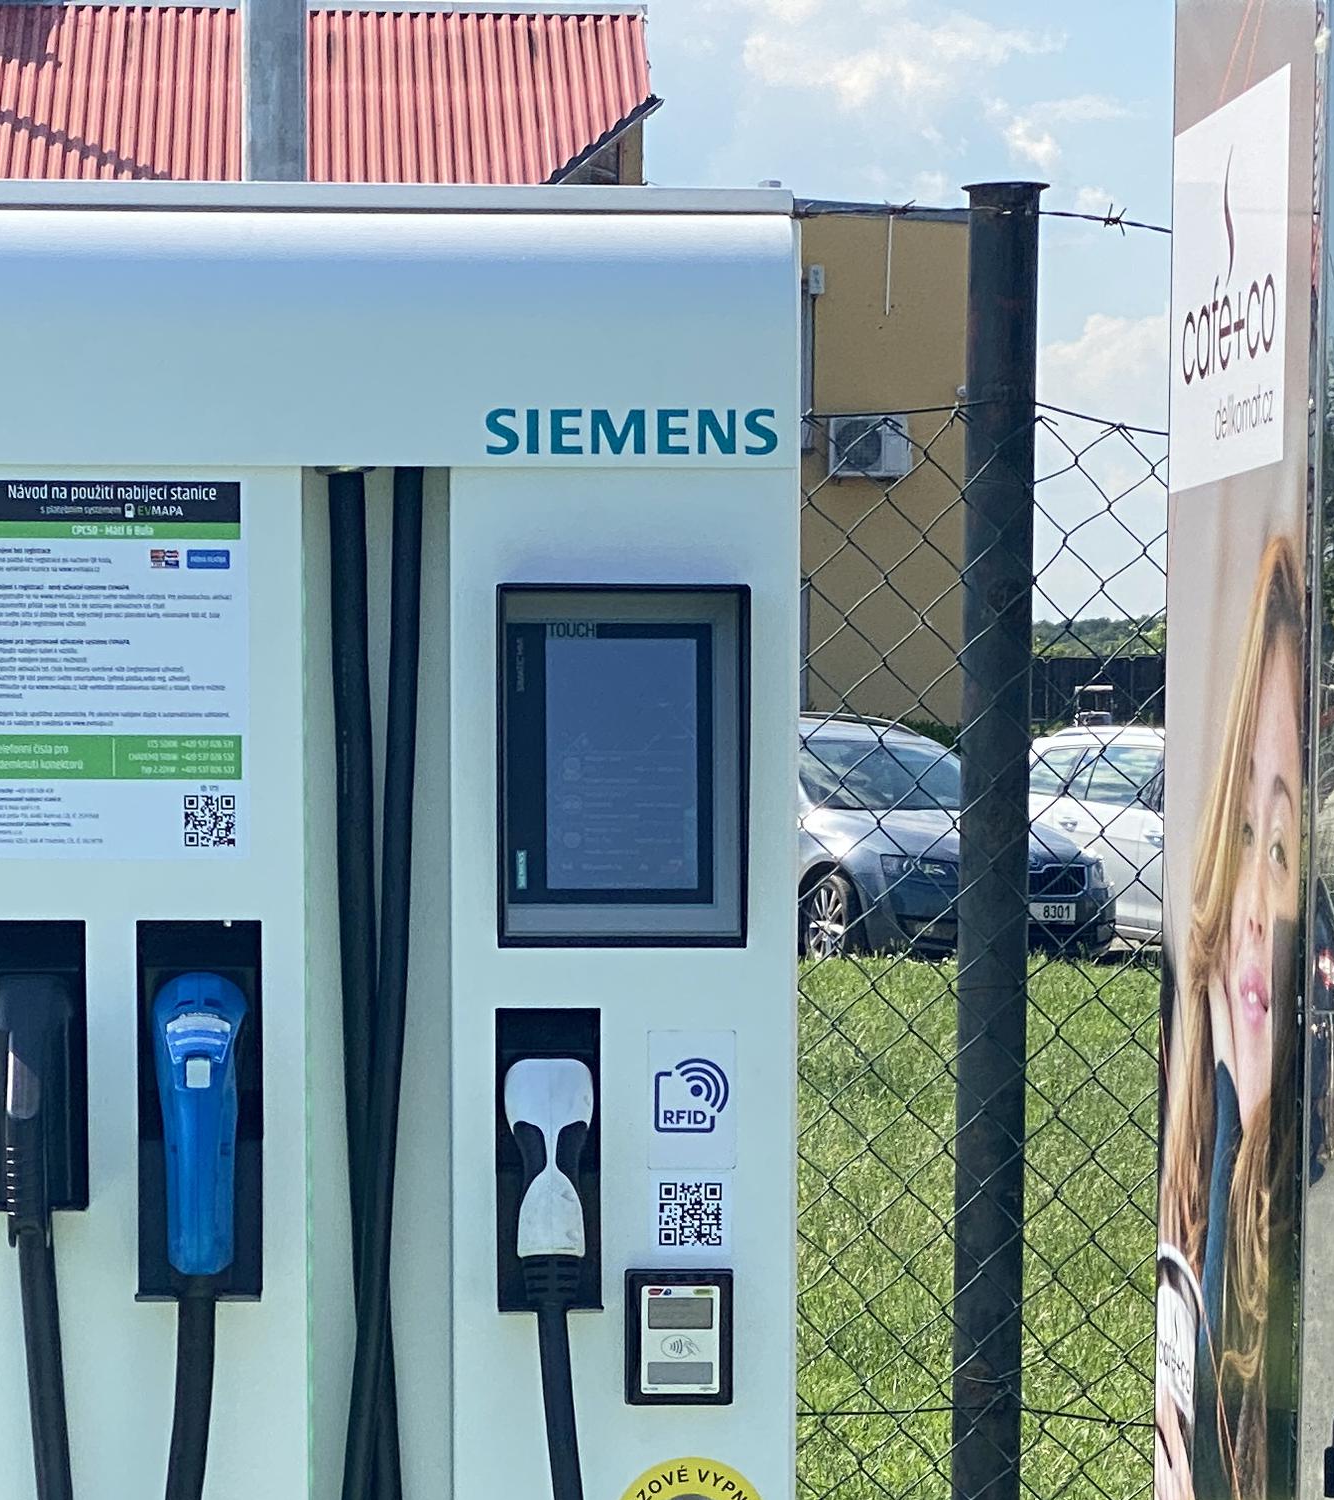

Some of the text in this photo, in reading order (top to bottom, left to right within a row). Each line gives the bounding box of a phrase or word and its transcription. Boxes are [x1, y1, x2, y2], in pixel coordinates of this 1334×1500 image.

[1182, 273, 1276, 386] café+co
[485, 408, 779, 456] SIEMENS
[8, 484, 47, 499] Návod
[51, 486, 68, 499] na
[170, 485, 217, 500] stanice
[547, 622, 597, 638] TOUCH
[663, 1110, 707, 1125] RFID
